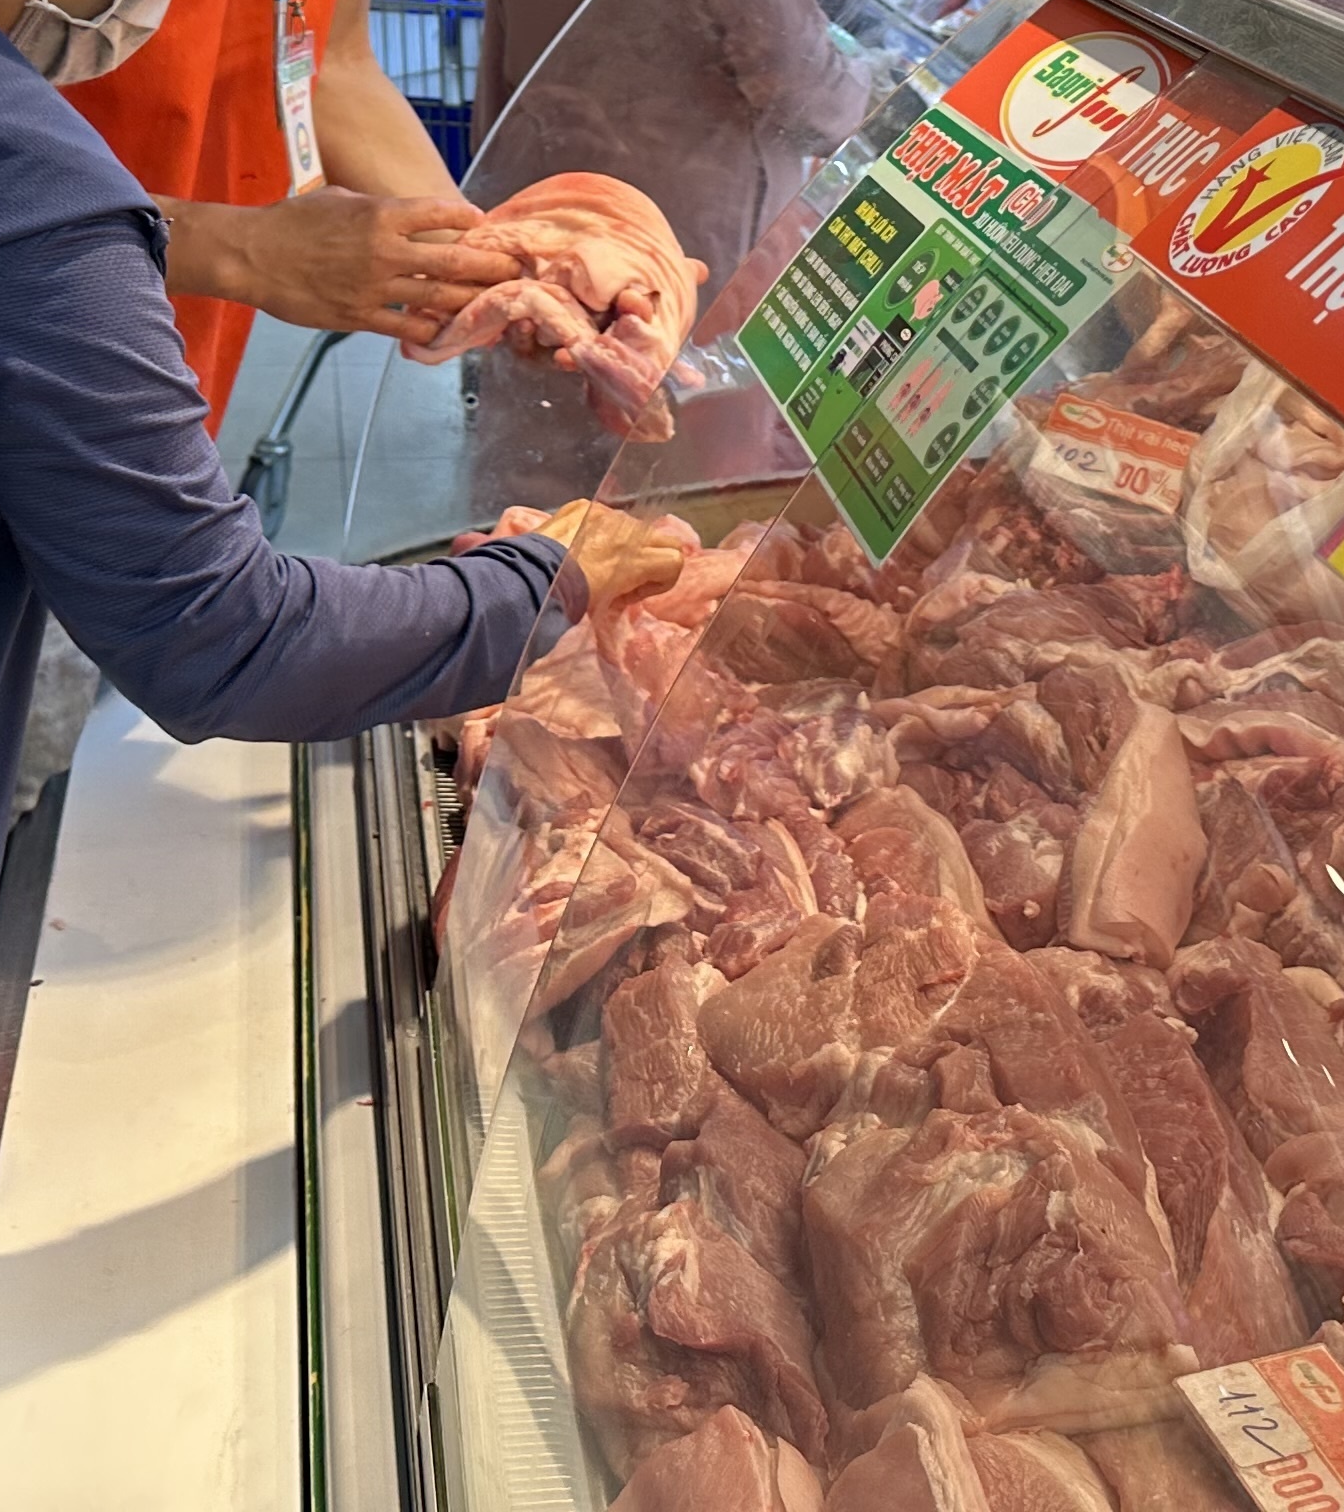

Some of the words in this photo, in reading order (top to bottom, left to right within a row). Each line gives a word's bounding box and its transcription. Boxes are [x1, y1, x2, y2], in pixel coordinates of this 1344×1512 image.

[892, 119, 963, 183] THỊT
[932, 152, 1009, 218] MÁT
[1028, 255, 1063, 291] HIỆN
[1179, 244, 1252, 276] LƯỢNG
[1264, 199, 1314, 242] CAO
[1218, 1391, 1289, 1461] 112
